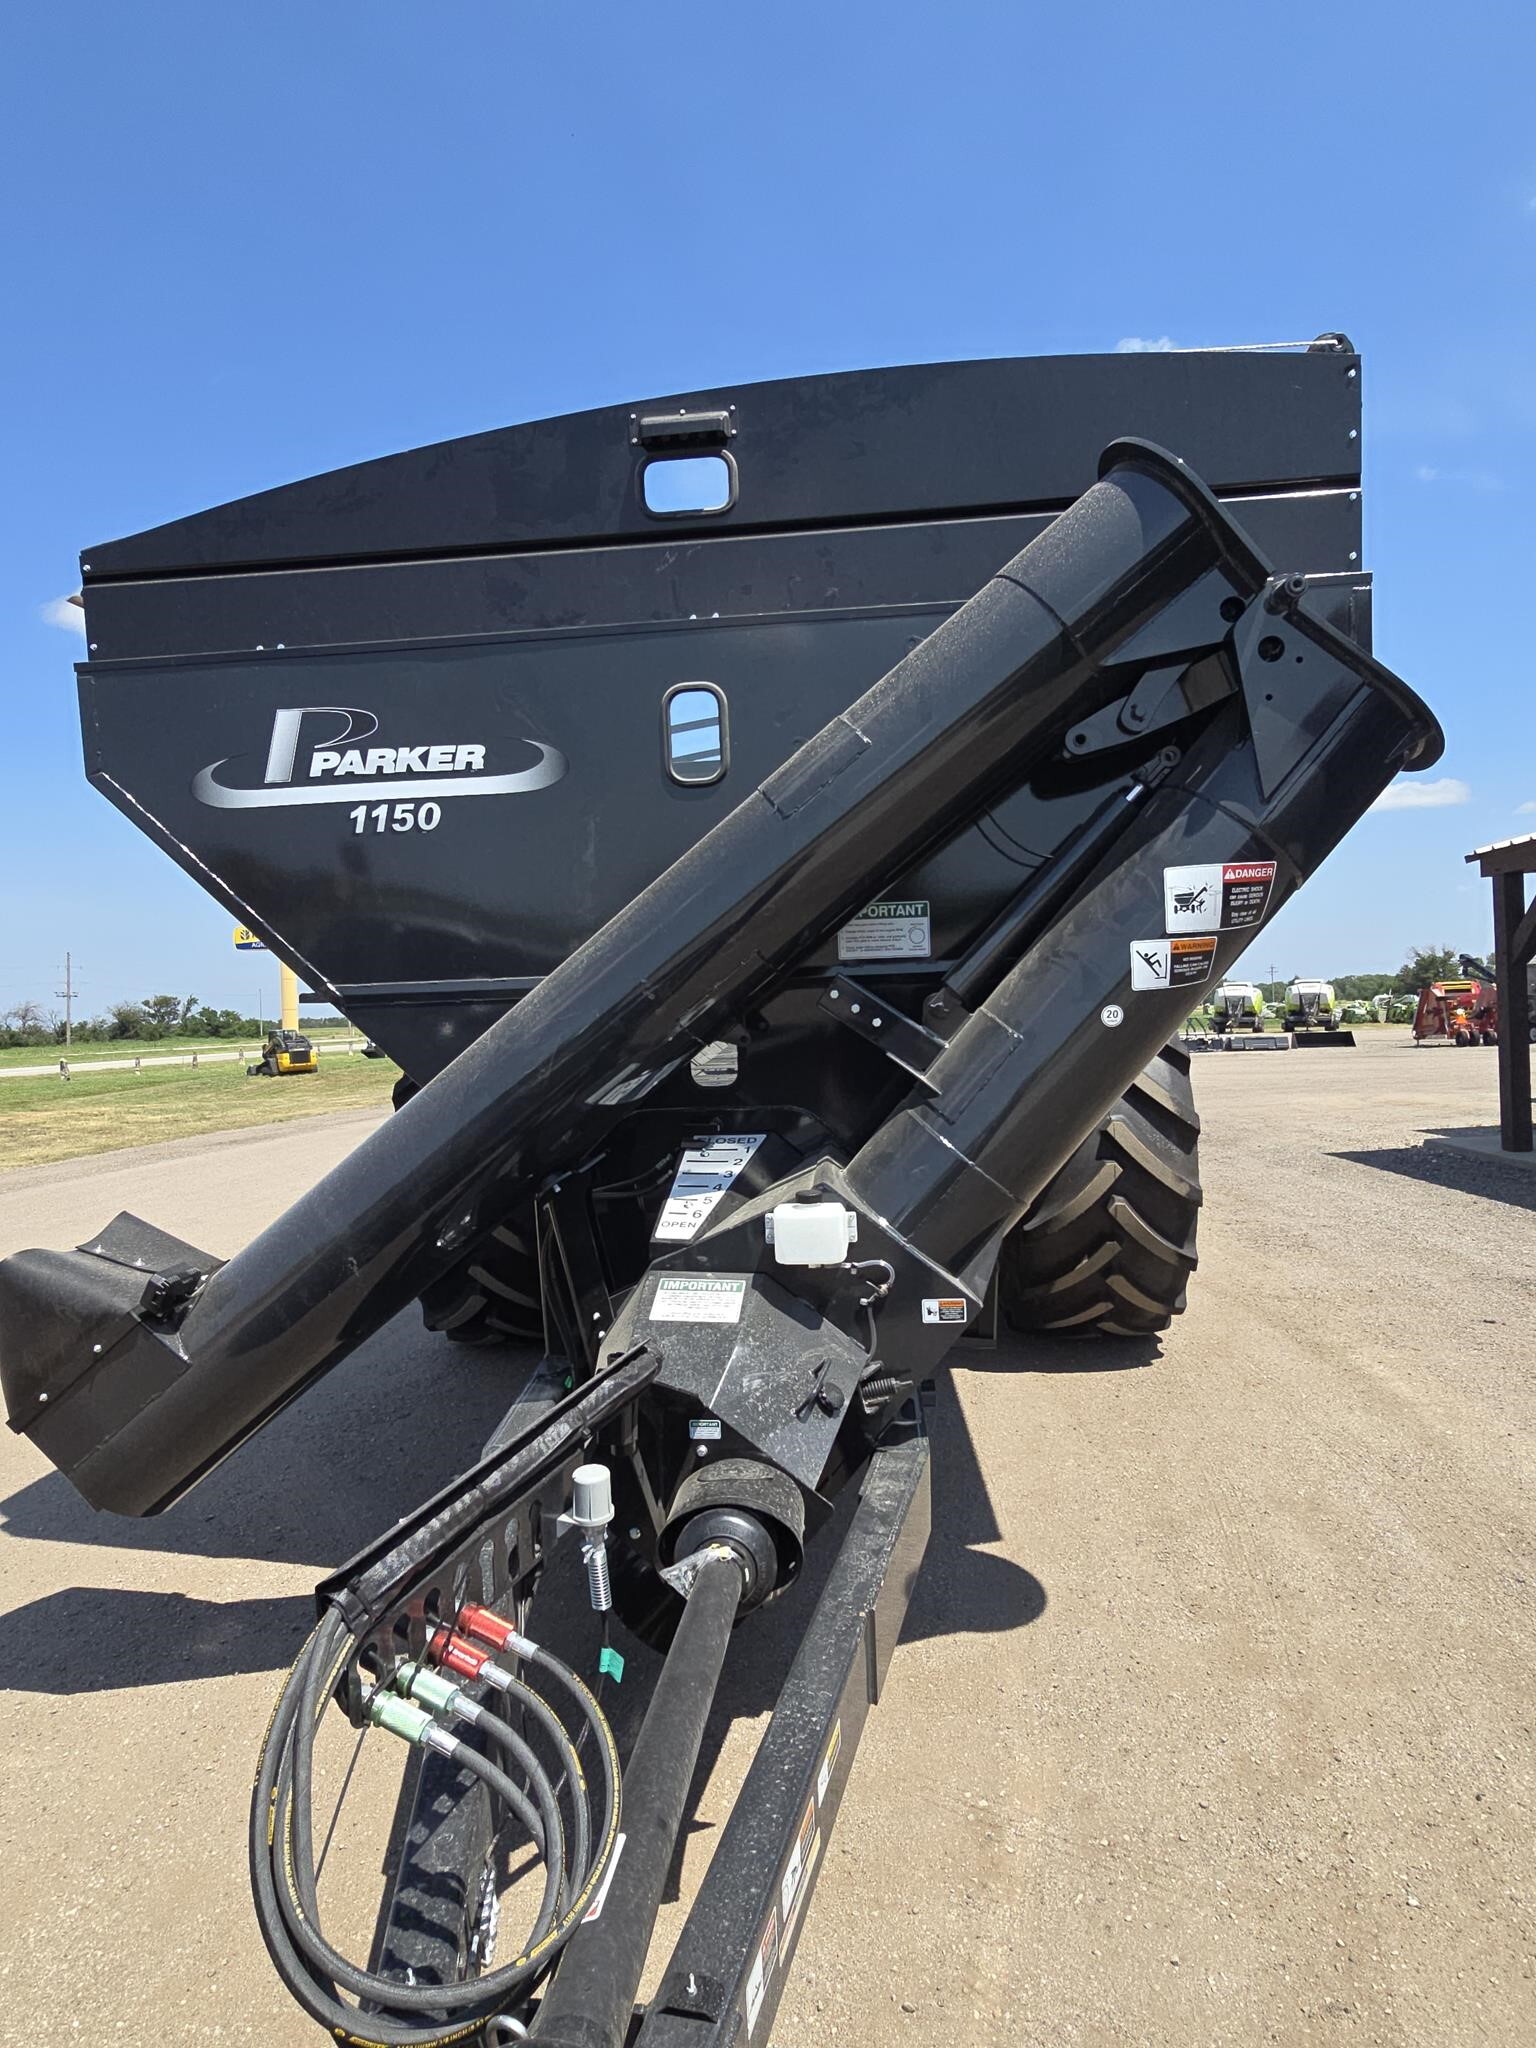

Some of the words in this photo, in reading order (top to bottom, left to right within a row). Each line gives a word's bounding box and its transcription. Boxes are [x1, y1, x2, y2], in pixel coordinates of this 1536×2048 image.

[309, 744, 486, 777] PARKER
[350, 802, 441, 834] 1150
[1235, 868, 1273, 879] DANGER
[1180, 942, 1214, 951] WARNING
[1106, 1009, 1119, 1019] 20
[744, 1146, 751, 1154] 1
[733, 1158, 743, 1166] 2
[723, 1170, 734, 1178] 3
[712, 1183, 723, 1191] 4
[703, 1196, 713, 1205] 5
[692, 1210, 703, 1219] 6
[661, 1221, 698, 1229] OPEN
[663, 1280, 740, 1292] IMPORTANT
